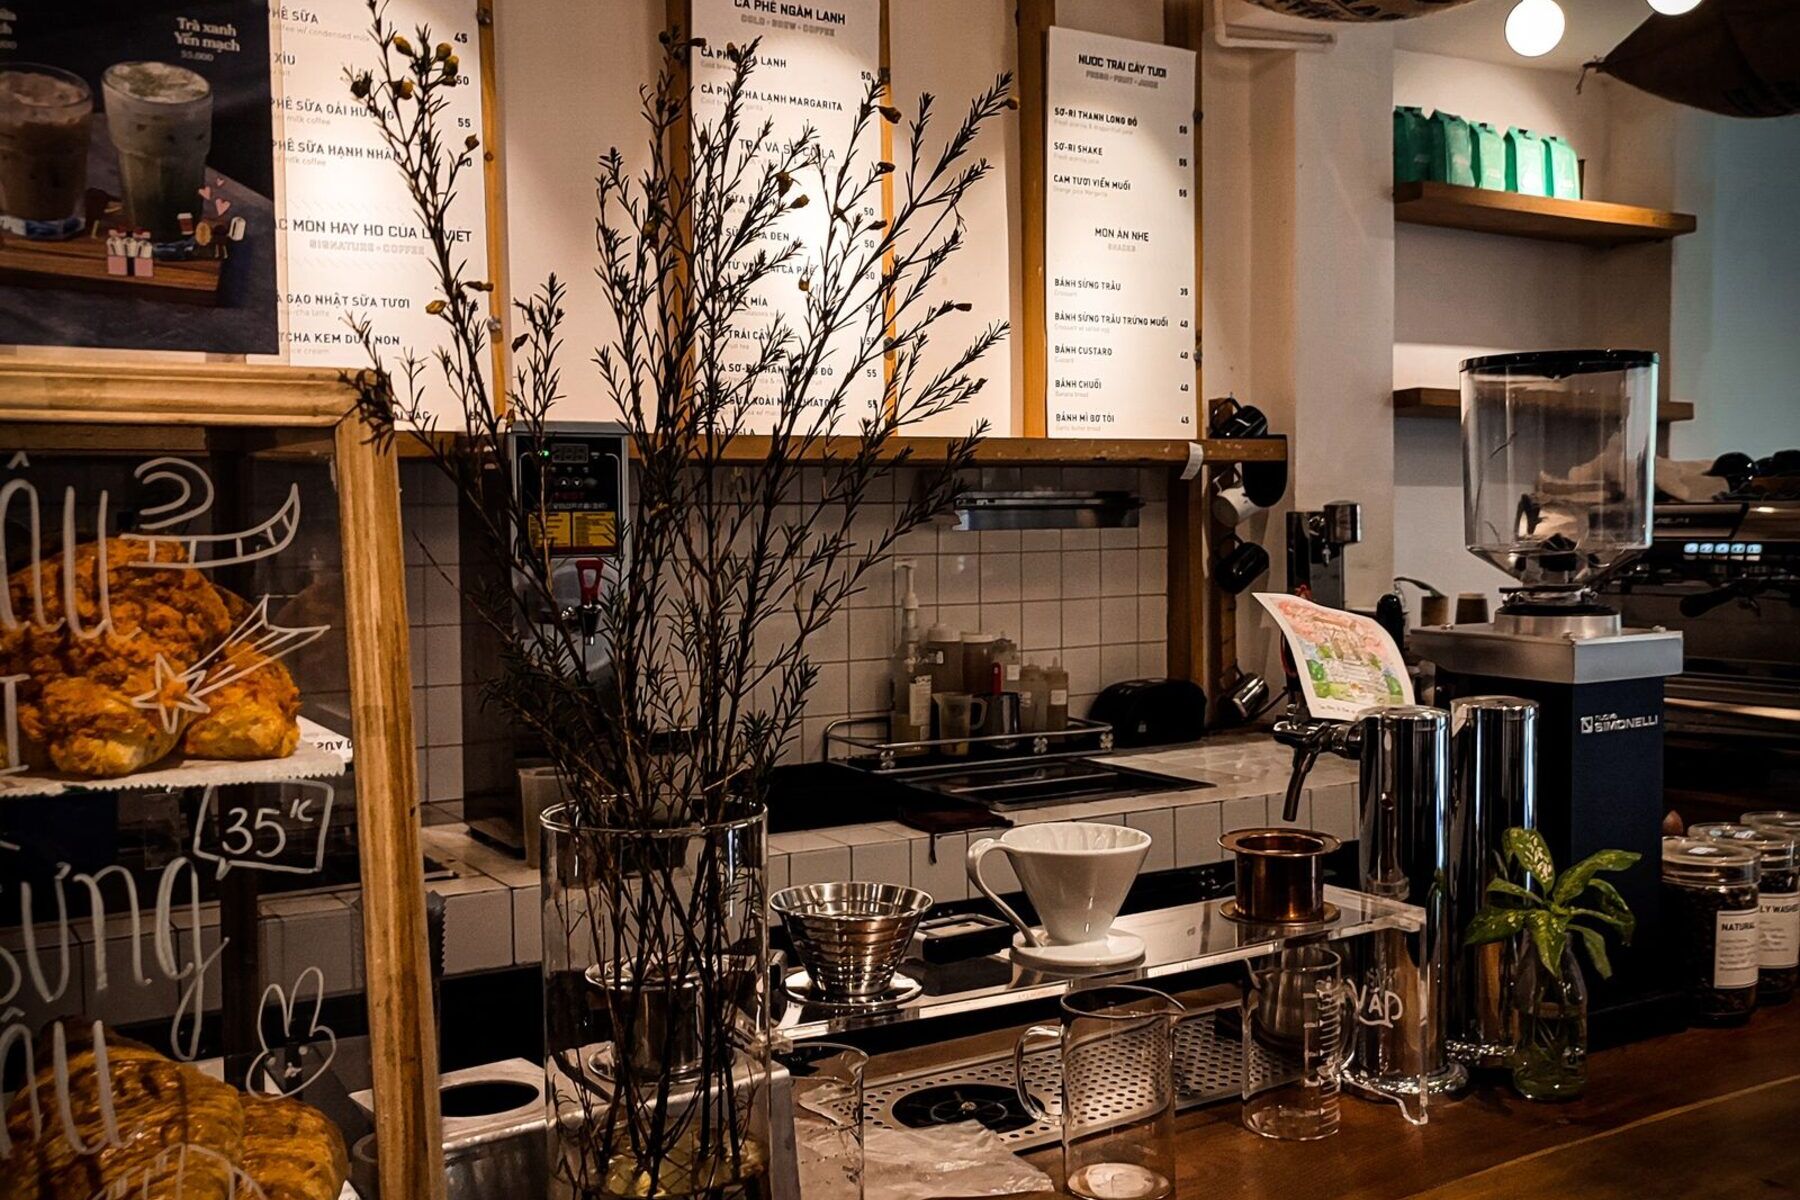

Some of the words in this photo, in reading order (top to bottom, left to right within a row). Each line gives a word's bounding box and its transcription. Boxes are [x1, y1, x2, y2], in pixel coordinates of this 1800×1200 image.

[176, 17, 201, 33] Trà
[203, 24, 237, 37] xanh
[454, 32, 468, 43] 45
[861, 71, 872, 81] 50
[701, 82, 715, 95] CÀ
[789, 96, 843, 112] MARGARITA
[296, 97, 323, 114] SỮA
[1078, 110, 1105, 122] THANH
[455, 117, 471, 128] 55
[298, 138, 325, 155] SỮA
[327, 144, 363, 160] HẠNH
[1077, 144, 1103, 156] SHAKE
[1053, 174, 1071, 185] CAM
[863, 206, 875, 217] 50
[329, 221, 360, 236] HAY
[864, 239, 875, 249] 50
[1054, 275, 1077, 288] BÁNH
[315, 291, 348, 309] NHẬT
[351, 293, 378, 308] SỮA
[381, 297, 411, 310] TƯƠI
[1054, 308, 1077, 322] BÁNH
[1180, 320, 1189, 329] 40
[314, 333, 342, 344] KEM
[375, 335, 400, 346] NON
[1054, 342, 1077, 354] BÁNH
[1180, 351, 1189, 360] 40
[866, 368, 878, 379] 55
[1055, 376, 1077, 389] BÁNH
[1180, 384, 1189, 393] 40
[1056, 410, 1078, 423] BÁNH
[1181, 415, 1190, 425] 45
[1594, 714, 1659, 733] SIMONELLI
